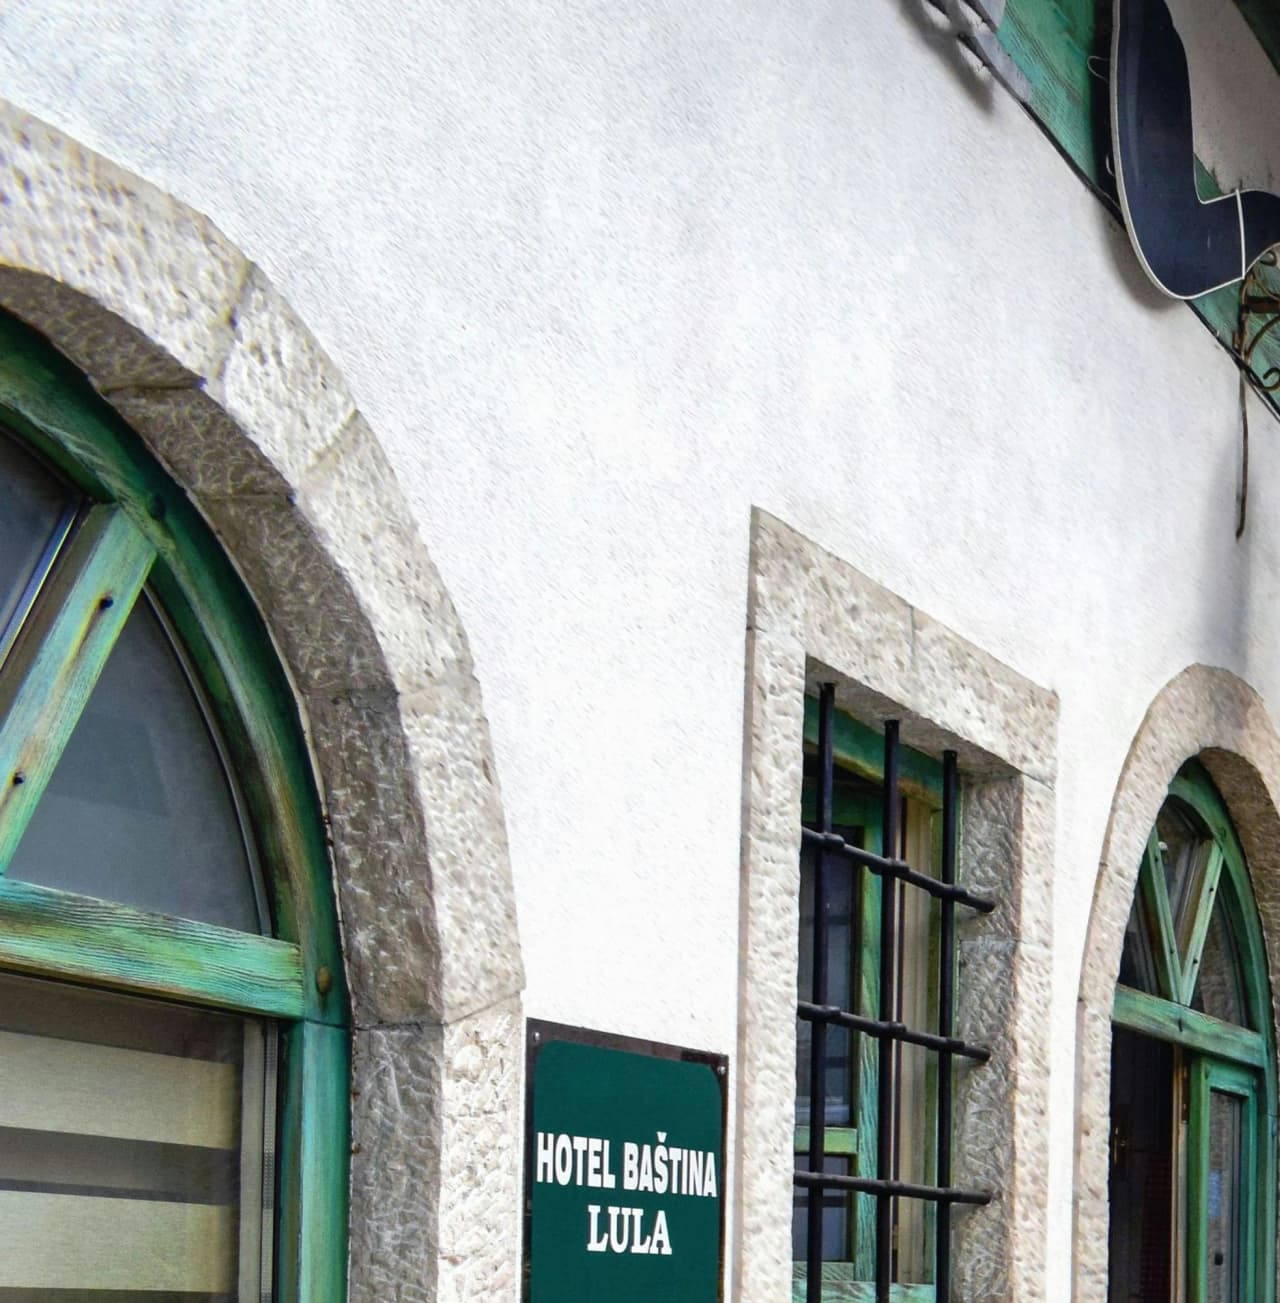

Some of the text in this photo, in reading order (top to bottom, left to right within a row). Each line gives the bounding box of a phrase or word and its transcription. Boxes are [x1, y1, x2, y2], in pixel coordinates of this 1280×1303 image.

[536, 1131, 718, 1198] HOTEL BAŠTINA
[586, 1204, 672, 1255] LULA
